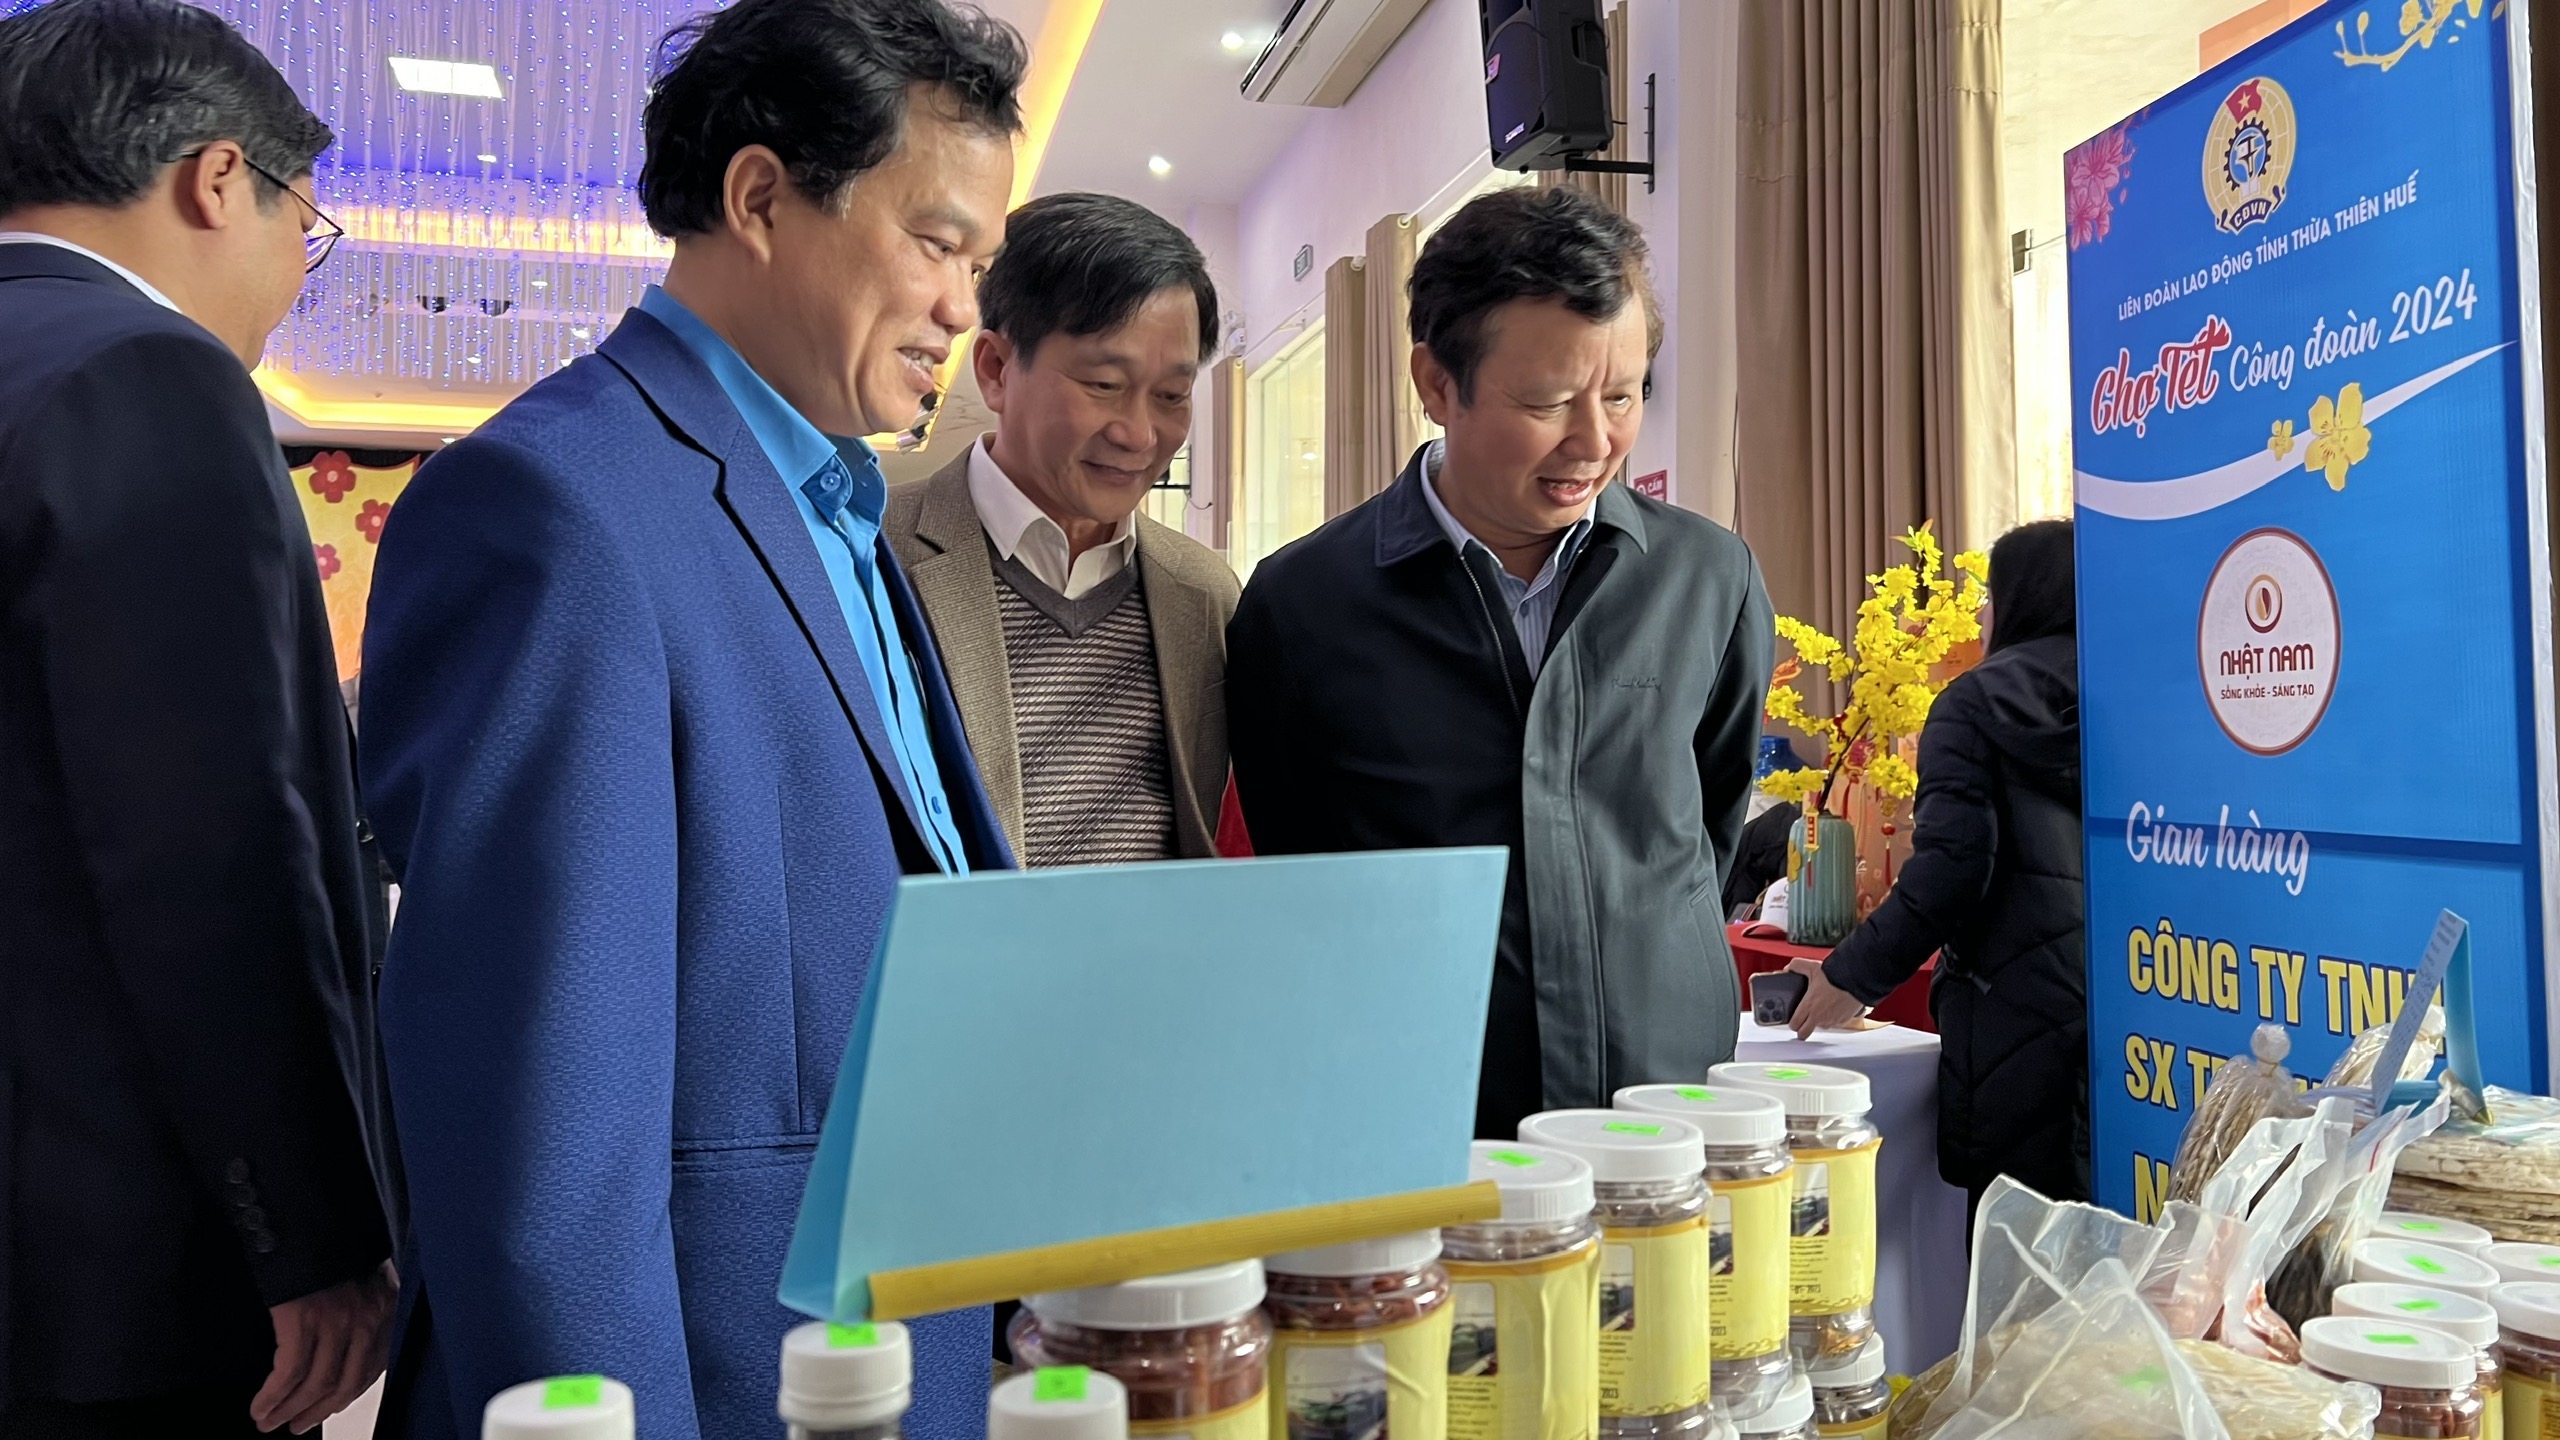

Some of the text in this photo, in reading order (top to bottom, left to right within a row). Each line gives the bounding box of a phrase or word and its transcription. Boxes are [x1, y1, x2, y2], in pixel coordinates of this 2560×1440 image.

[2118, 168, 2420, 321] LIÊN ĐOÀN LAO ĐỘNG TỈNH THỪA THIÊN HUẾ
[2233, 200, 2268, 227] CĐVN
[2091, 268, 2478, 438] Chợ Tết Công đoàn 2024
[2220, 642, 2314, 680] NHẬT NAM
[2272, 683, 2296, 697] SÁNG
[2297, 684, 2315, 699] TẠO
[2126, 800, 2310, 896] Gian hàng
[2127, 917, 2240, 1012] CÔNG
[2250, 947, 2306, 1026] TY
[2124, 1033, 2178, 1110] SX
